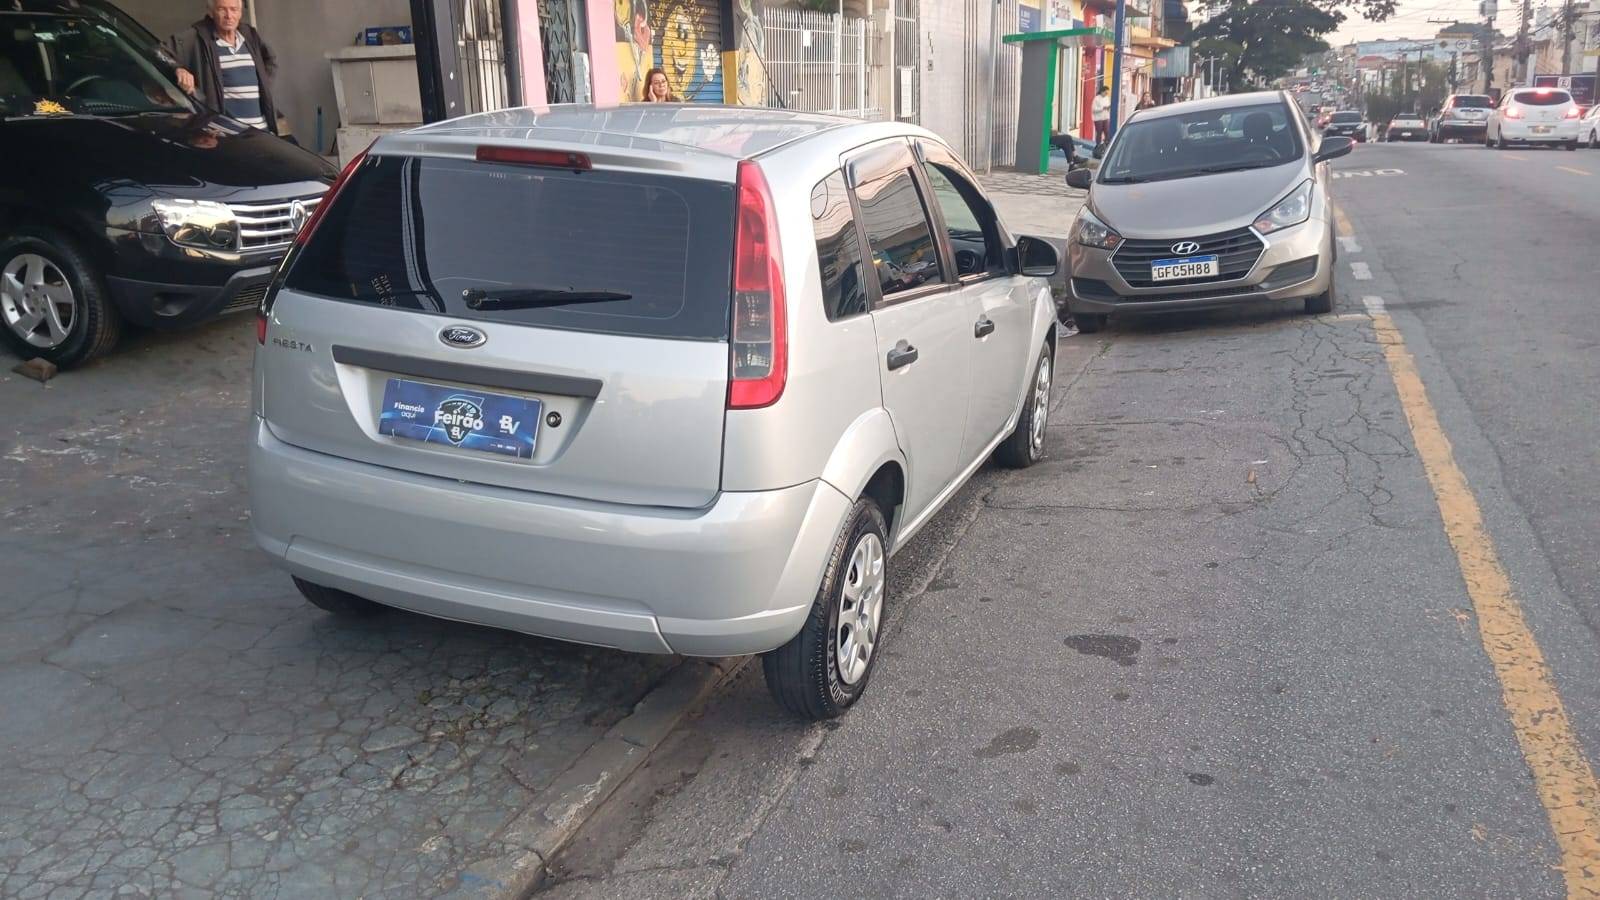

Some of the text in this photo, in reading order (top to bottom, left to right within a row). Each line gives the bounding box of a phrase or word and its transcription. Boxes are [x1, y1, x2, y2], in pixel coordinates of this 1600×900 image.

[1157, 262, 1211, 279] GFC5H88
[449, 329, 474, 342] Ford
[272, 337, 313, 352] FIESTA
[434, 410, 484, 431] Feirão
